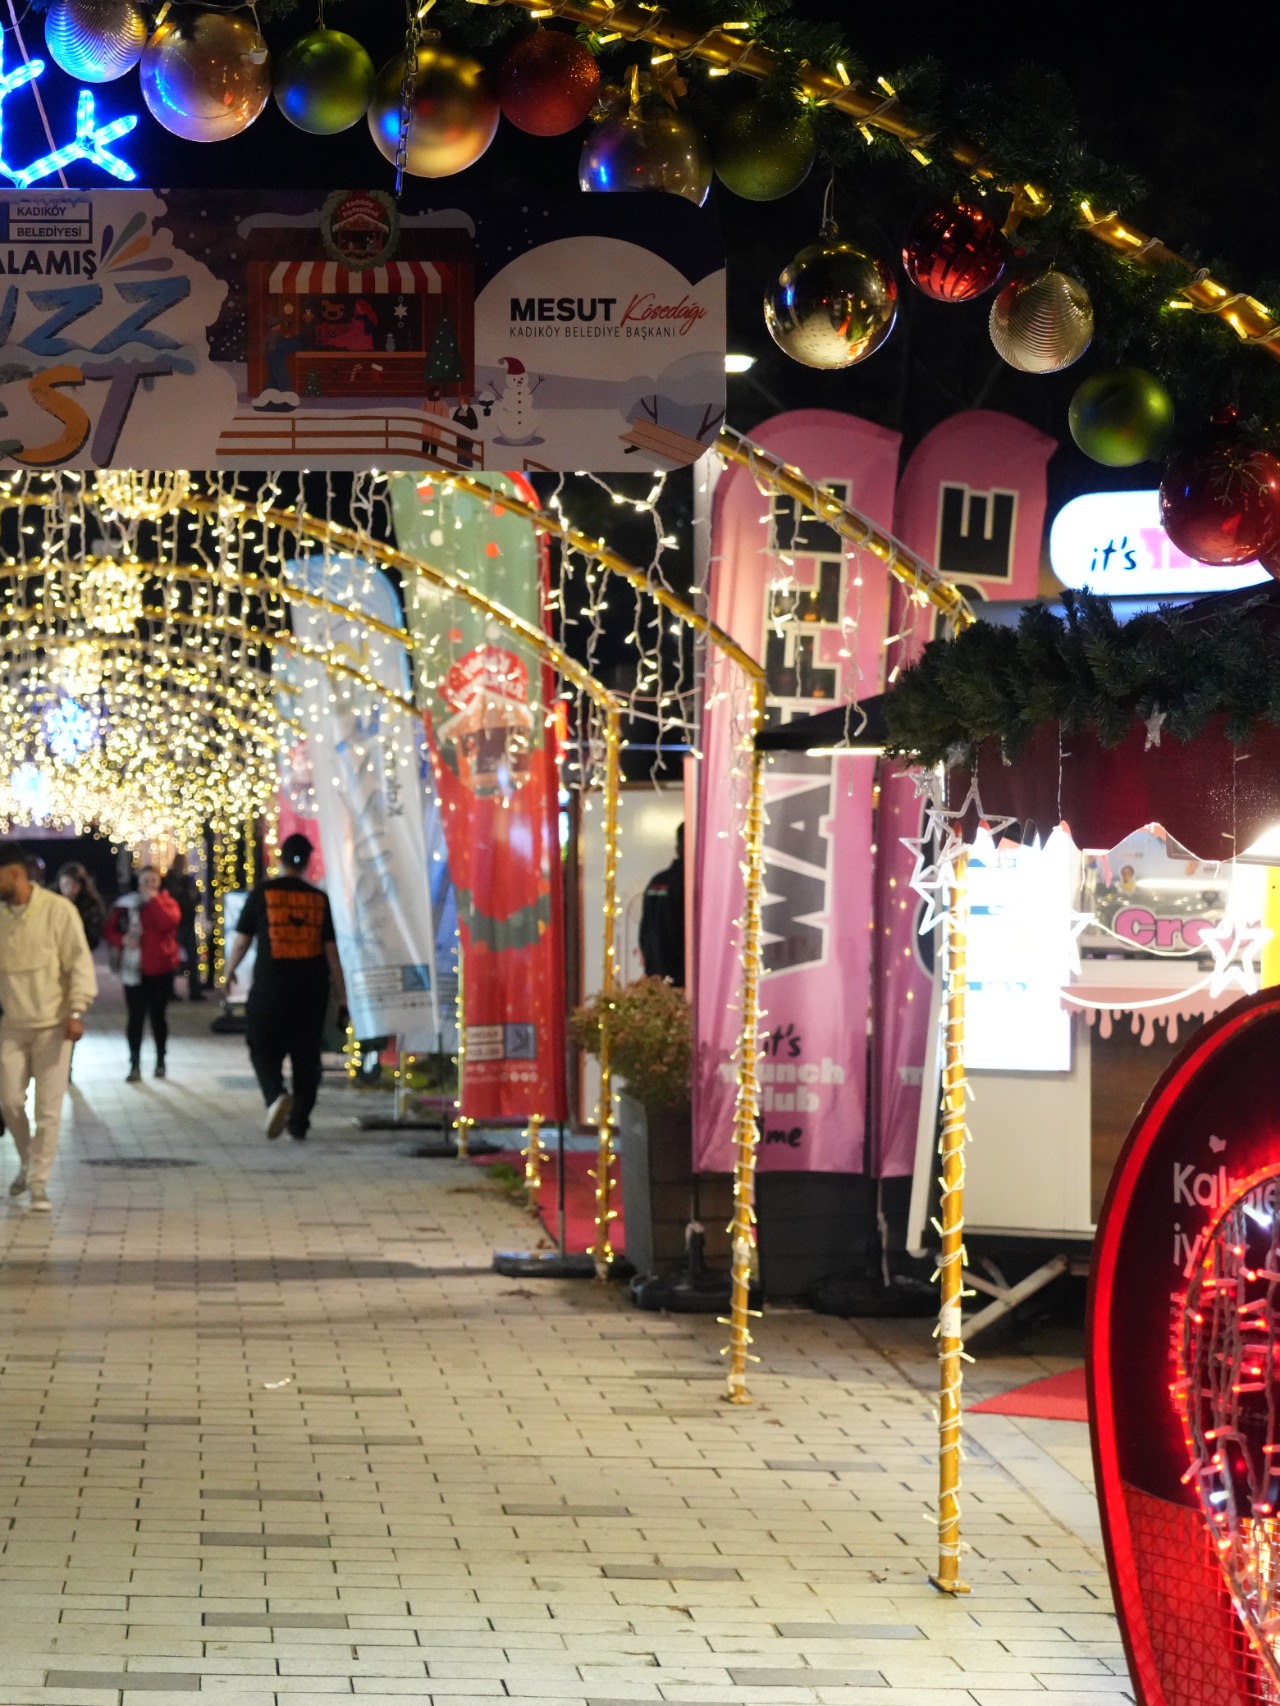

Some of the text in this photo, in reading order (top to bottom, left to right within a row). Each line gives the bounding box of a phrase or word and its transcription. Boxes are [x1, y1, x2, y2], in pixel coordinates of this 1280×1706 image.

[17, 205, 67, 217] KADIKÖY
[17, 225, 82, 237] BELEDİYESİ
[510, 292, 708, 336] MESUT Kösedağı
[510, 324, 676, 340] KADIKÖY BELEDİYE BAŞKANI
[1091, 536, 1137, 572] it's
[748, 1086, 820, 1113] lub
